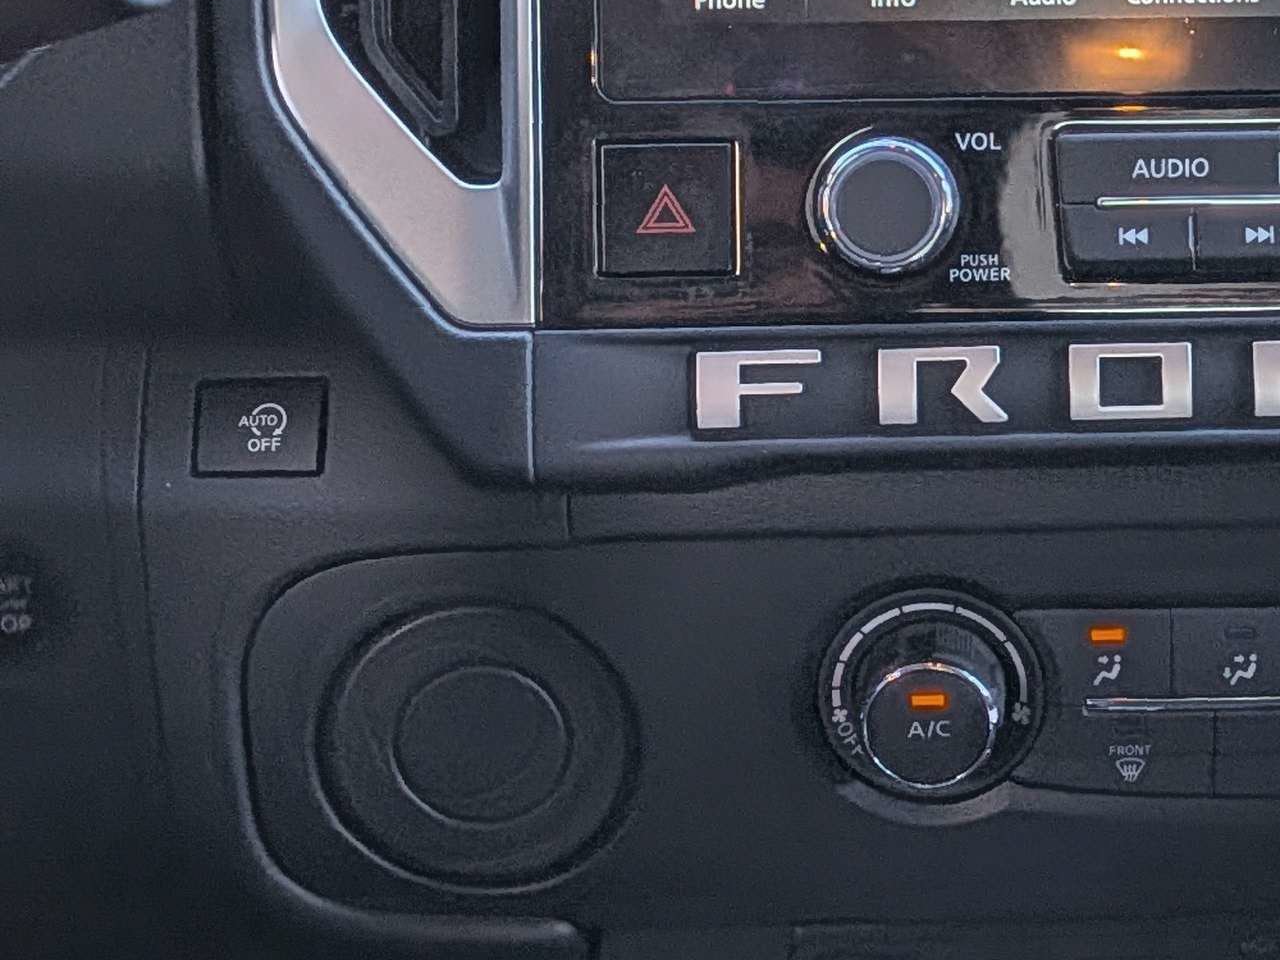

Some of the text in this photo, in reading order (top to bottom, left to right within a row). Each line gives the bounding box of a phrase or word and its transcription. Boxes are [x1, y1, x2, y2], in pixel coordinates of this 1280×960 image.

[955, 133, 1001, 151] VOL
[1132, 157, 1209, 179] AUDIO
[961, 254, 999, 267] PUSH
[949, 267, 1010, 282] POWER
[238, 414, 278, 427] AUTO
[247, 437, 281, 452] OFF
[907, 720, 952, 738] A/C
[1109, 744, 1151, 756] FRONT
